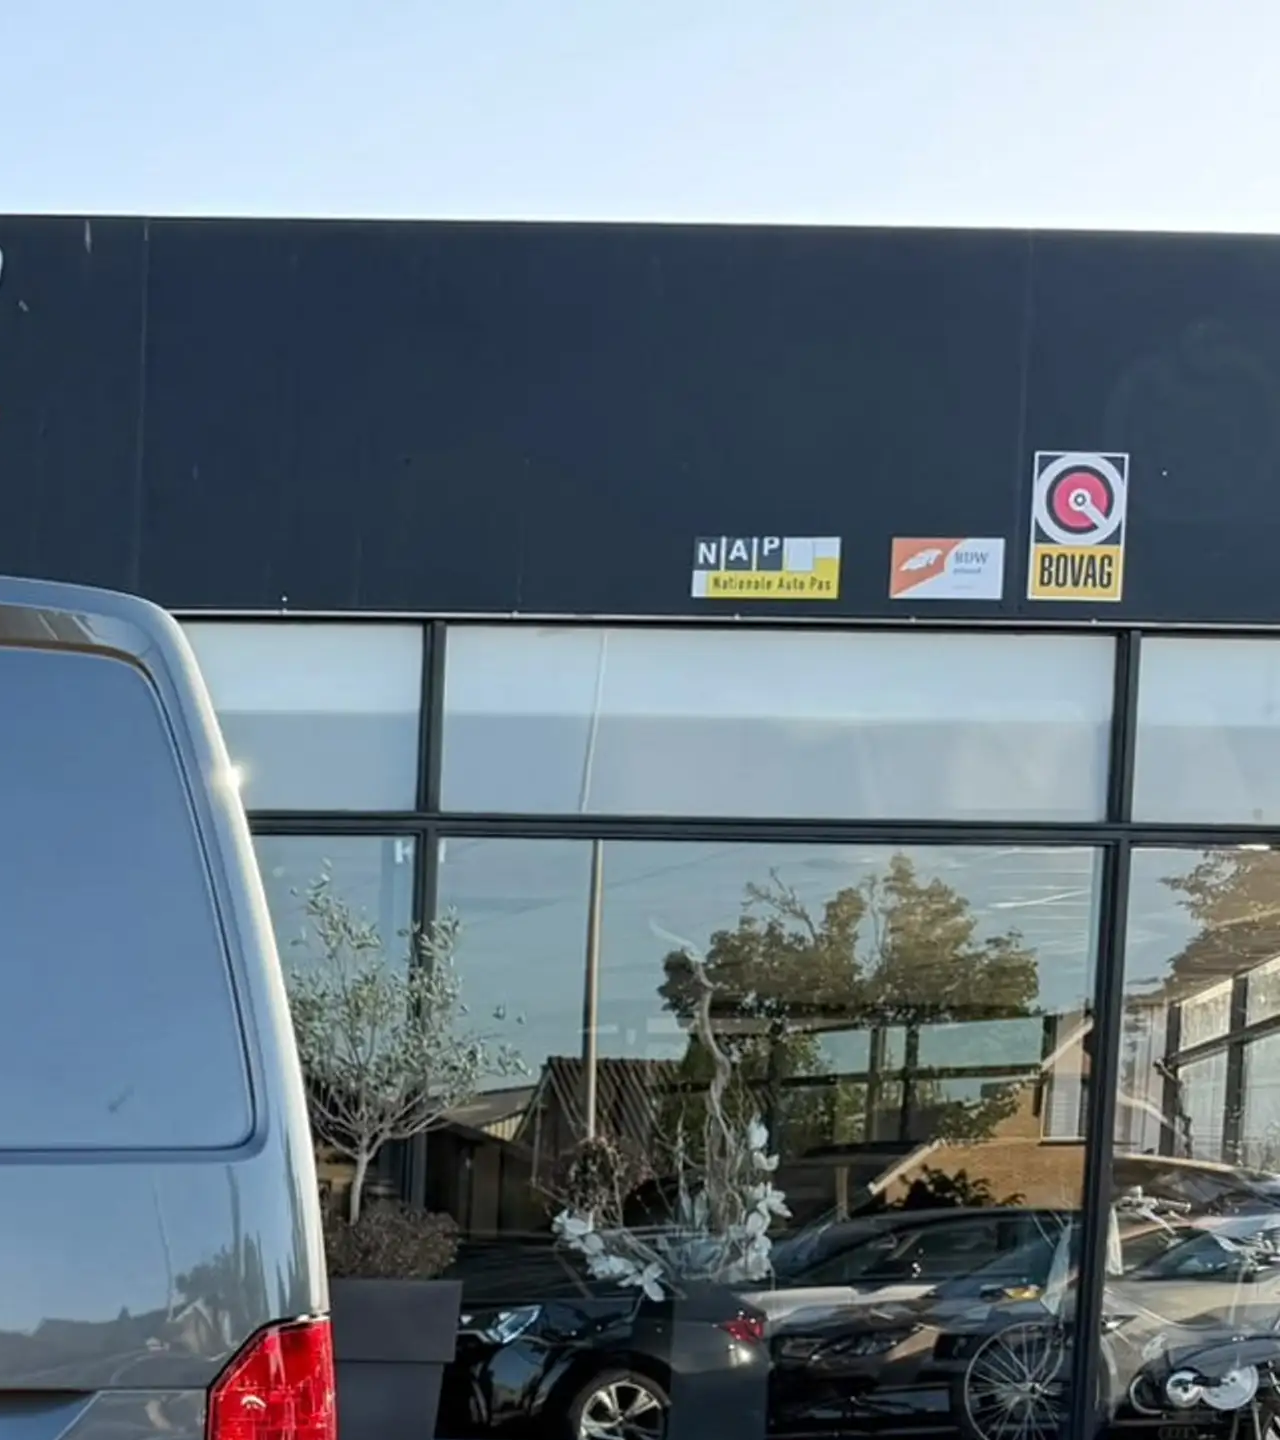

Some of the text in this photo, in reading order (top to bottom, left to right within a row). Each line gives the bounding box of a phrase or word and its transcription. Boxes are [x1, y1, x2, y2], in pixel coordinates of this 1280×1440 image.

[712, 576, 832, 591] Nationale Auto Pas
[1039, 552, 1113, 589] BOVAG
